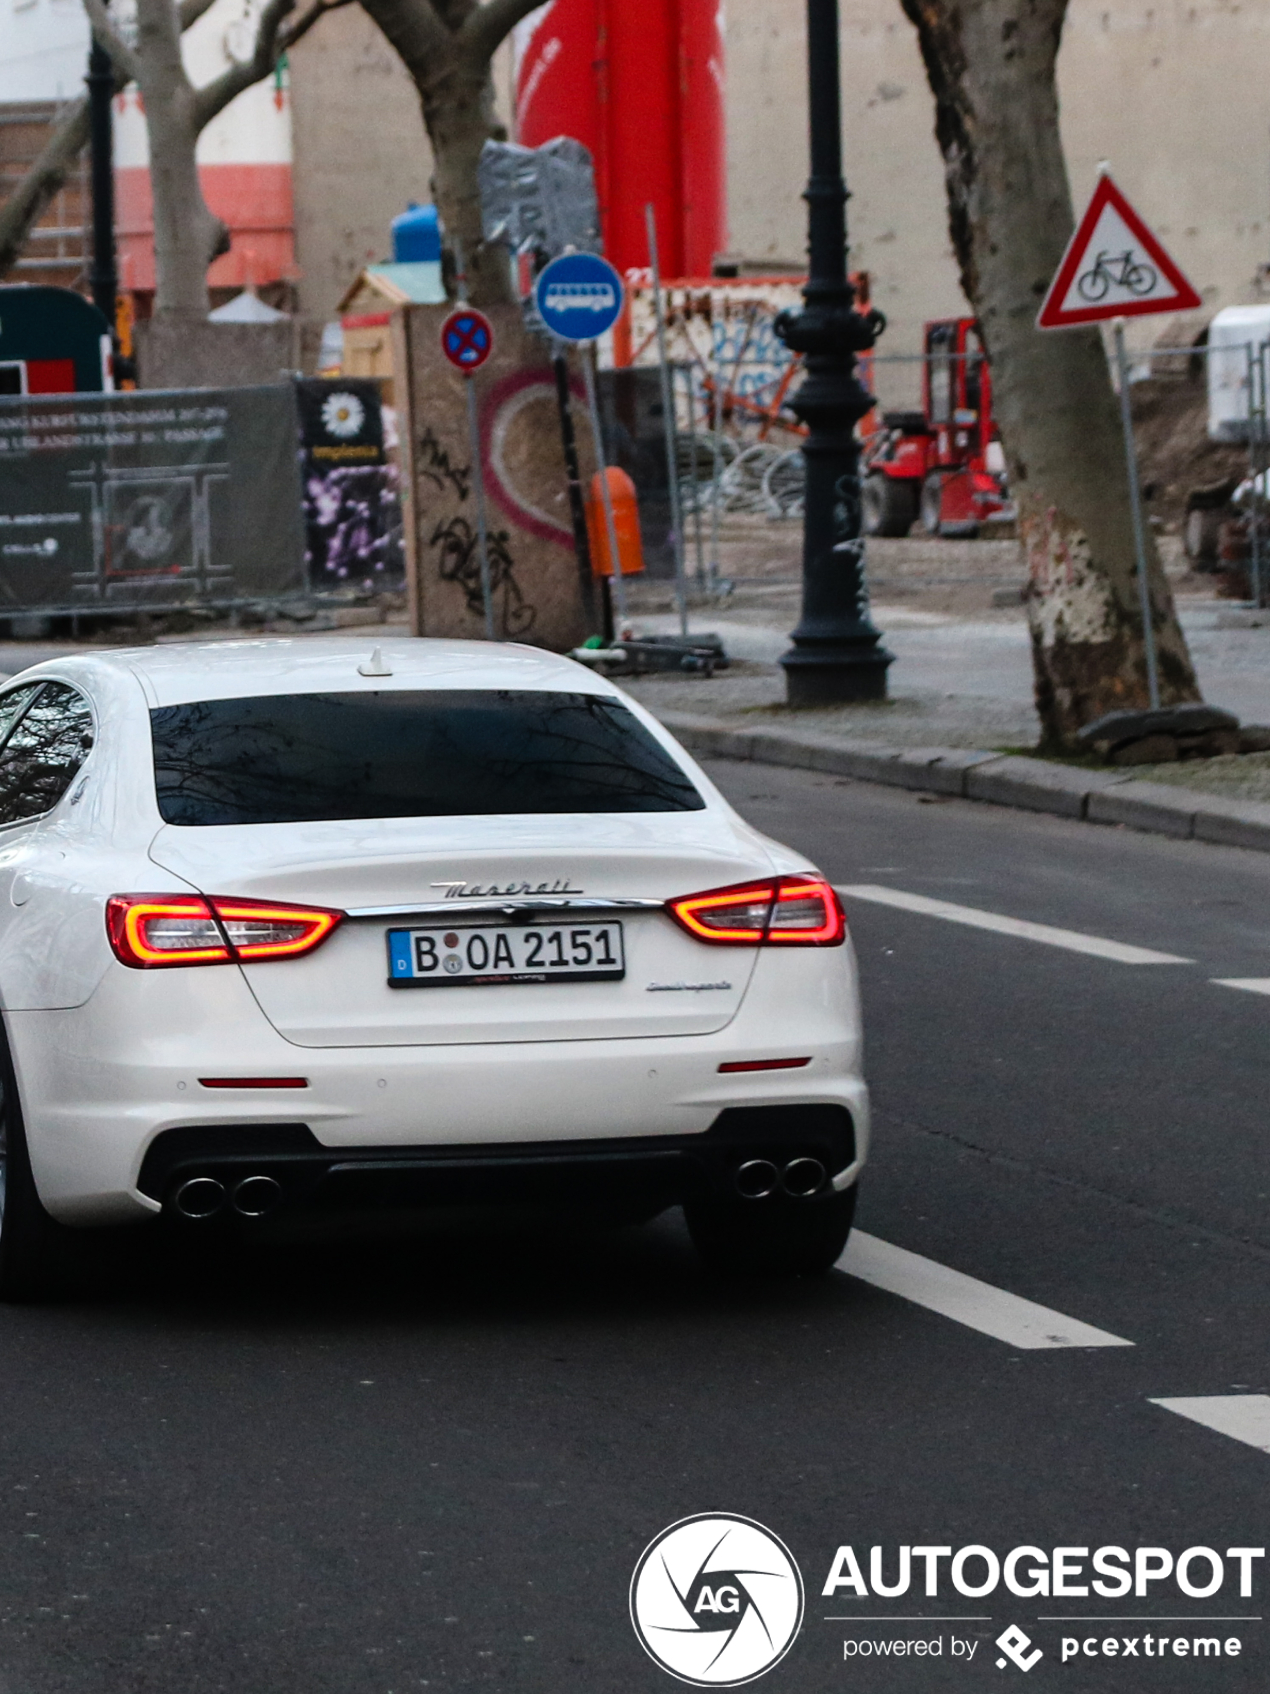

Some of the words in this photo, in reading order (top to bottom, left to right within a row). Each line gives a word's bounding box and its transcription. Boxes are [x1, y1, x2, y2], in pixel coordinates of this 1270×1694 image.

[430, 878, 584, 899] Maserati
[415, 935, 440, 972] B
[466, 933, 515, 970] OA
[523, 929, 617, 968] 2151
[397, 959, 407, 971] D
